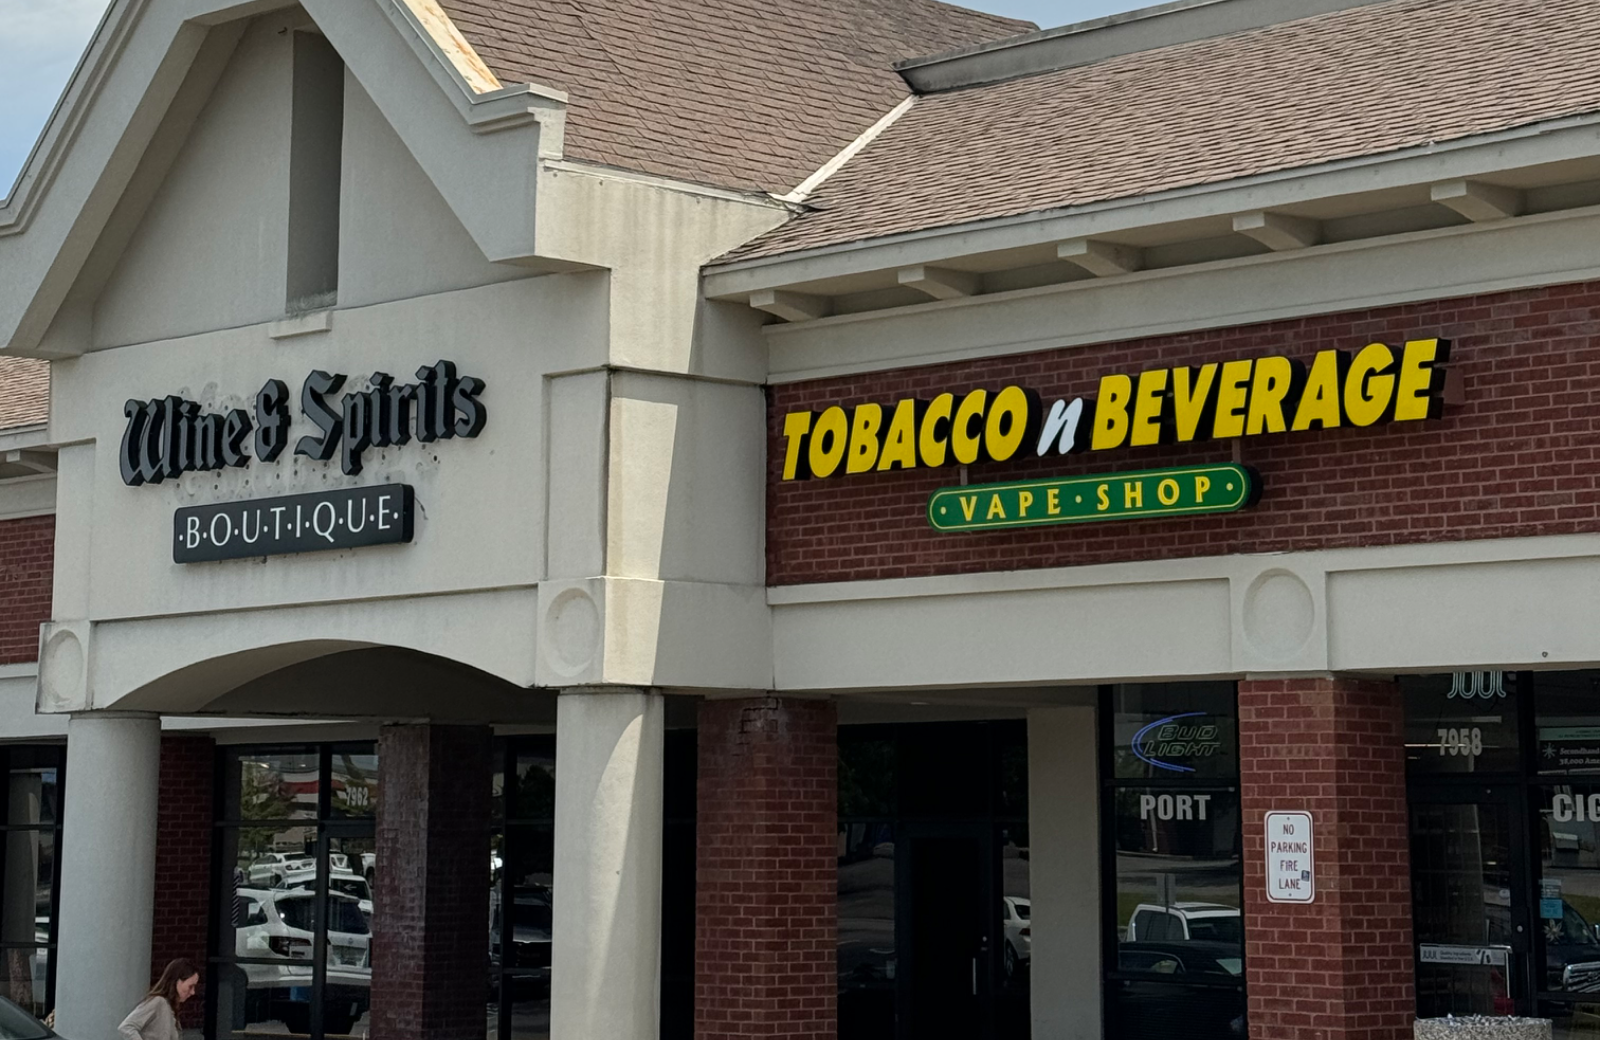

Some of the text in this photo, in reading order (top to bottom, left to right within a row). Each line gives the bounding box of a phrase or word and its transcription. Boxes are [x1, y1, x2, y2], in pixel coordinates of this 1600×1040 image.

[781, 338, 1440, 482] TOBACCO n BEVERAGE
[119, 359, 488, 487] Wine & Spirits
[960, 476, 1212, 523] VAPE SHOP
[1447, 670, 1507, 699] JUUL
[1143, 740, 1221, 757] LIGHT
[1437, 727, 1483, 756] 7958
[346, 787, 368, 806] 7962
[1140, 794, 1211, 821] PORT
[1283, 824, 1295, 835] NO
[1270, 841, 1308, 853] PARKING
[1280, 860, 1299, 872] FIRE
[1278, 878, 1301, 890] LANE
